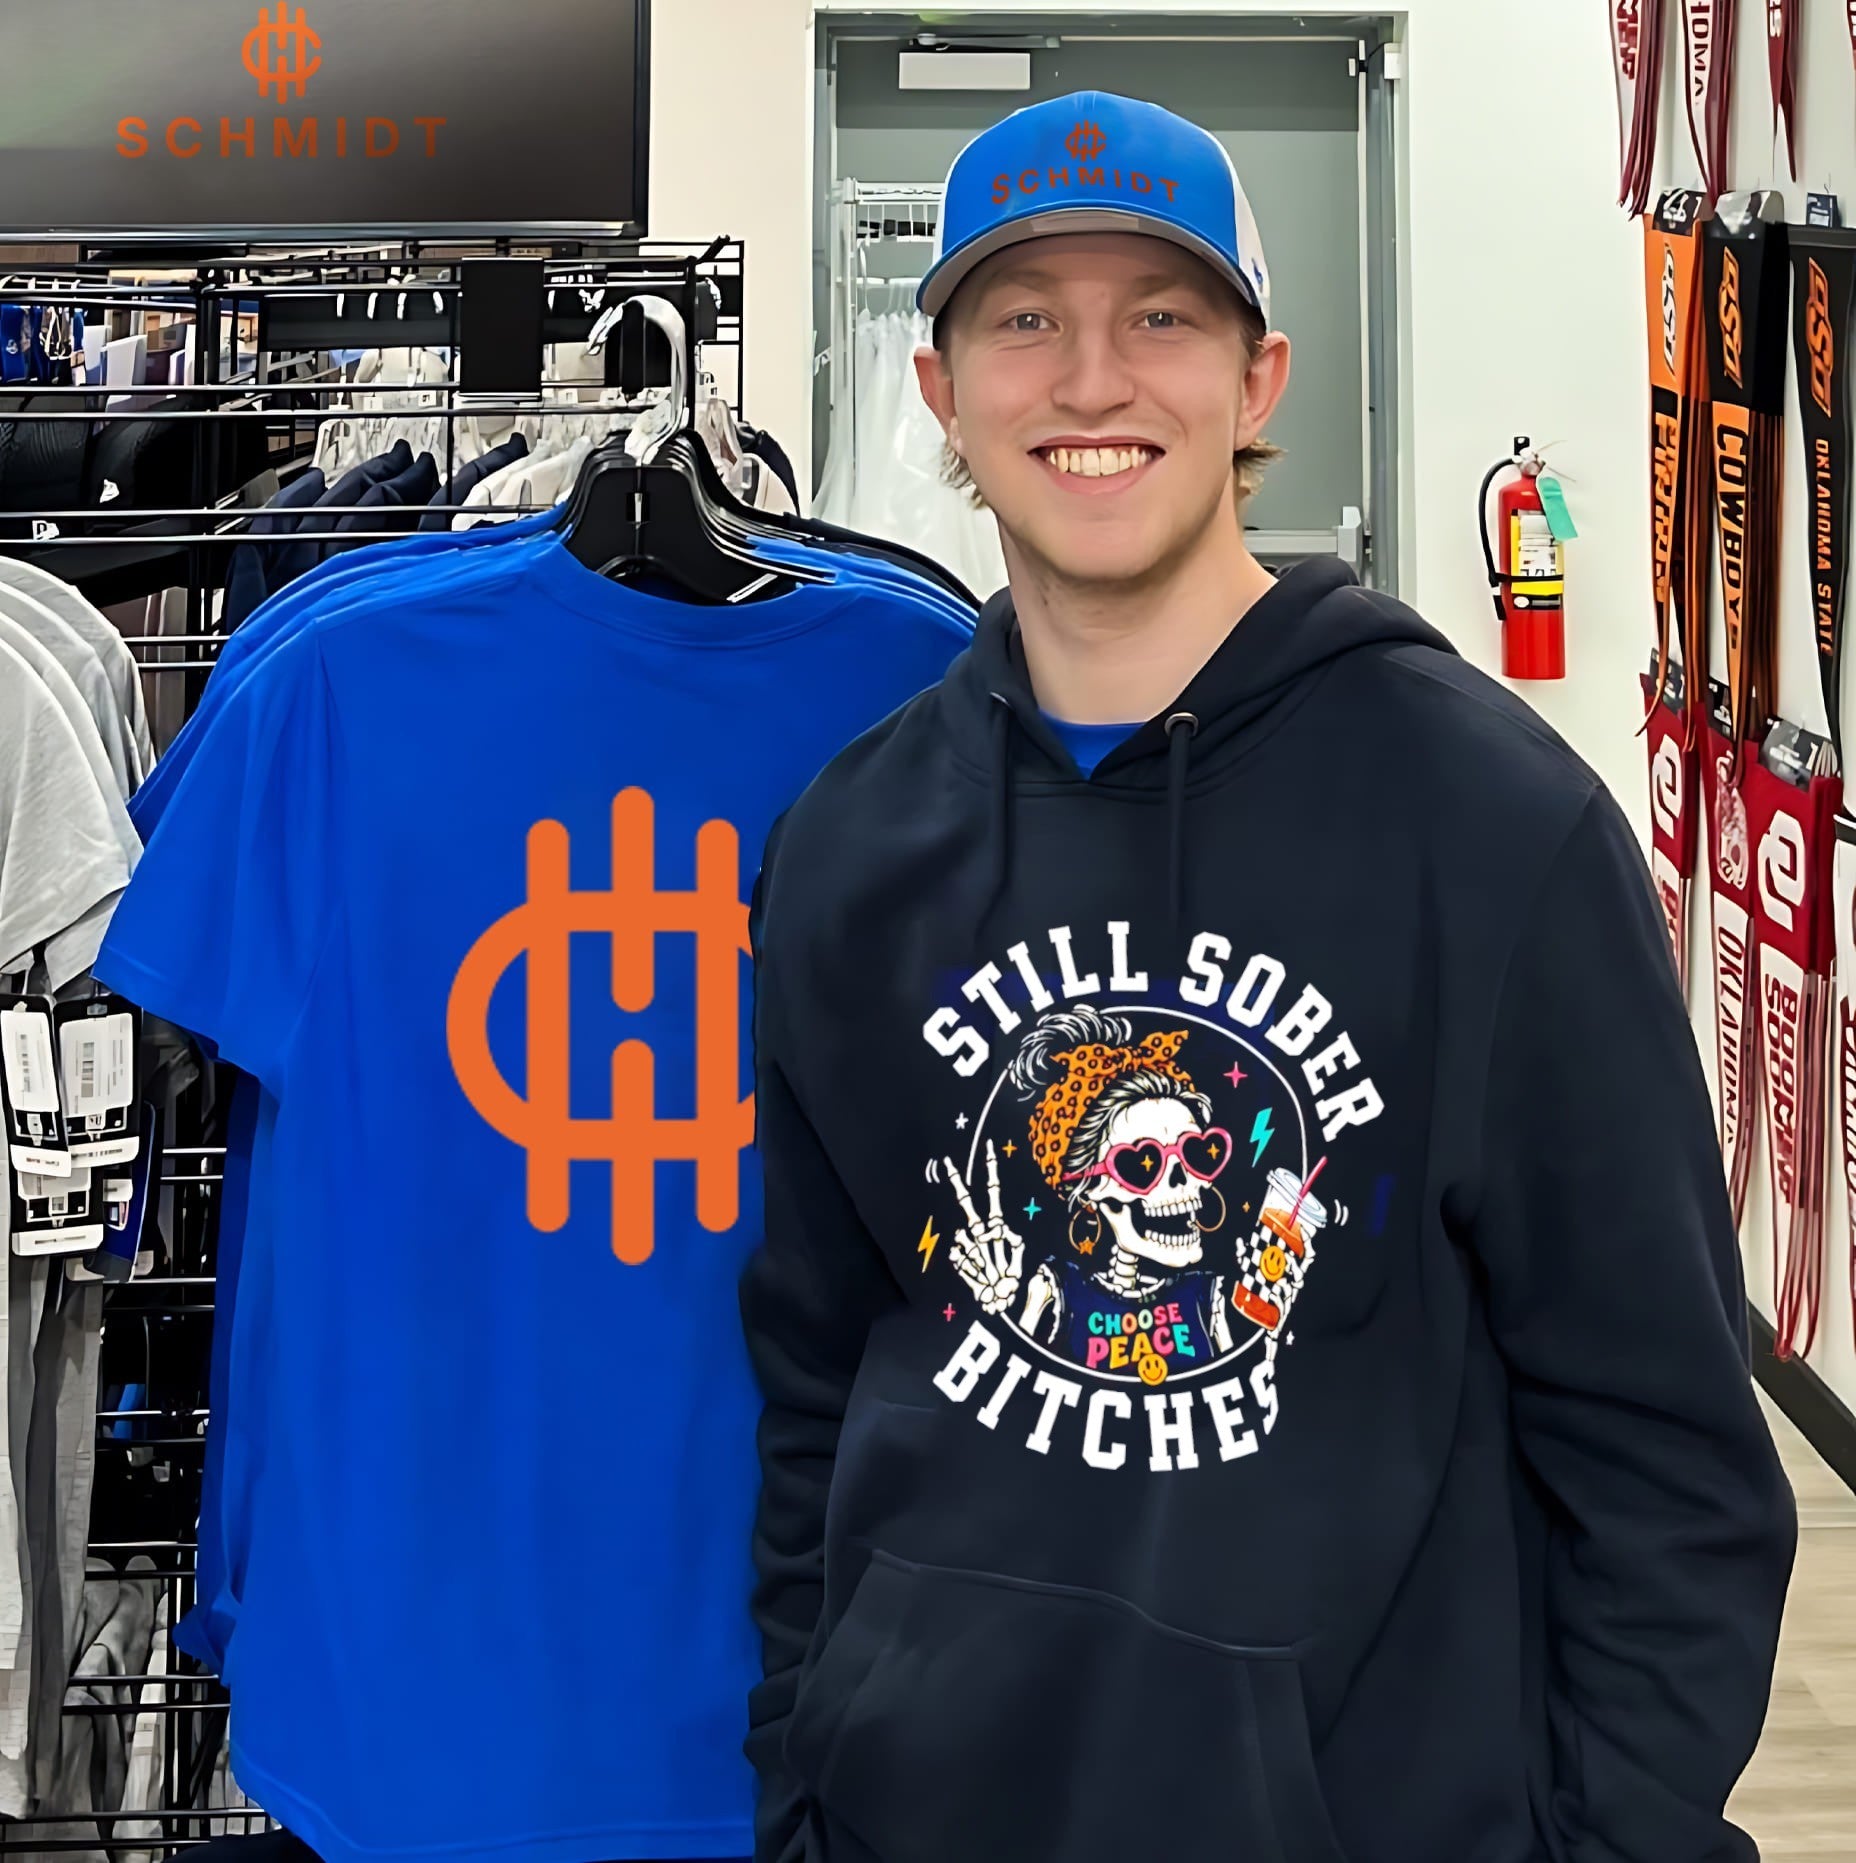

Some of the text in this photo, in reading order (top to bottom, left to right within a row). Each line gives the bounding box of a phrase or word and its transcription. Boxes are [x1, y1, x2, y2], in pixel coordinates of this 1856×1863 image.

[116, 116, 447, 159] SCHMIDT
[991, 167, 1179, 205] SCHMIDT
[1815, 438, 1832, 570] OKLAHOMA
[923, 921, 1384, 1142] STILL SOBER
[1717, 925, 1745, 1144] OKLAHOMA
[1086, 1324, 1196, 1369] PEACE
[1088, 1303, 1183, 1335] CHOOSE
[933, 1320, 1279, 1472] BITCHES
